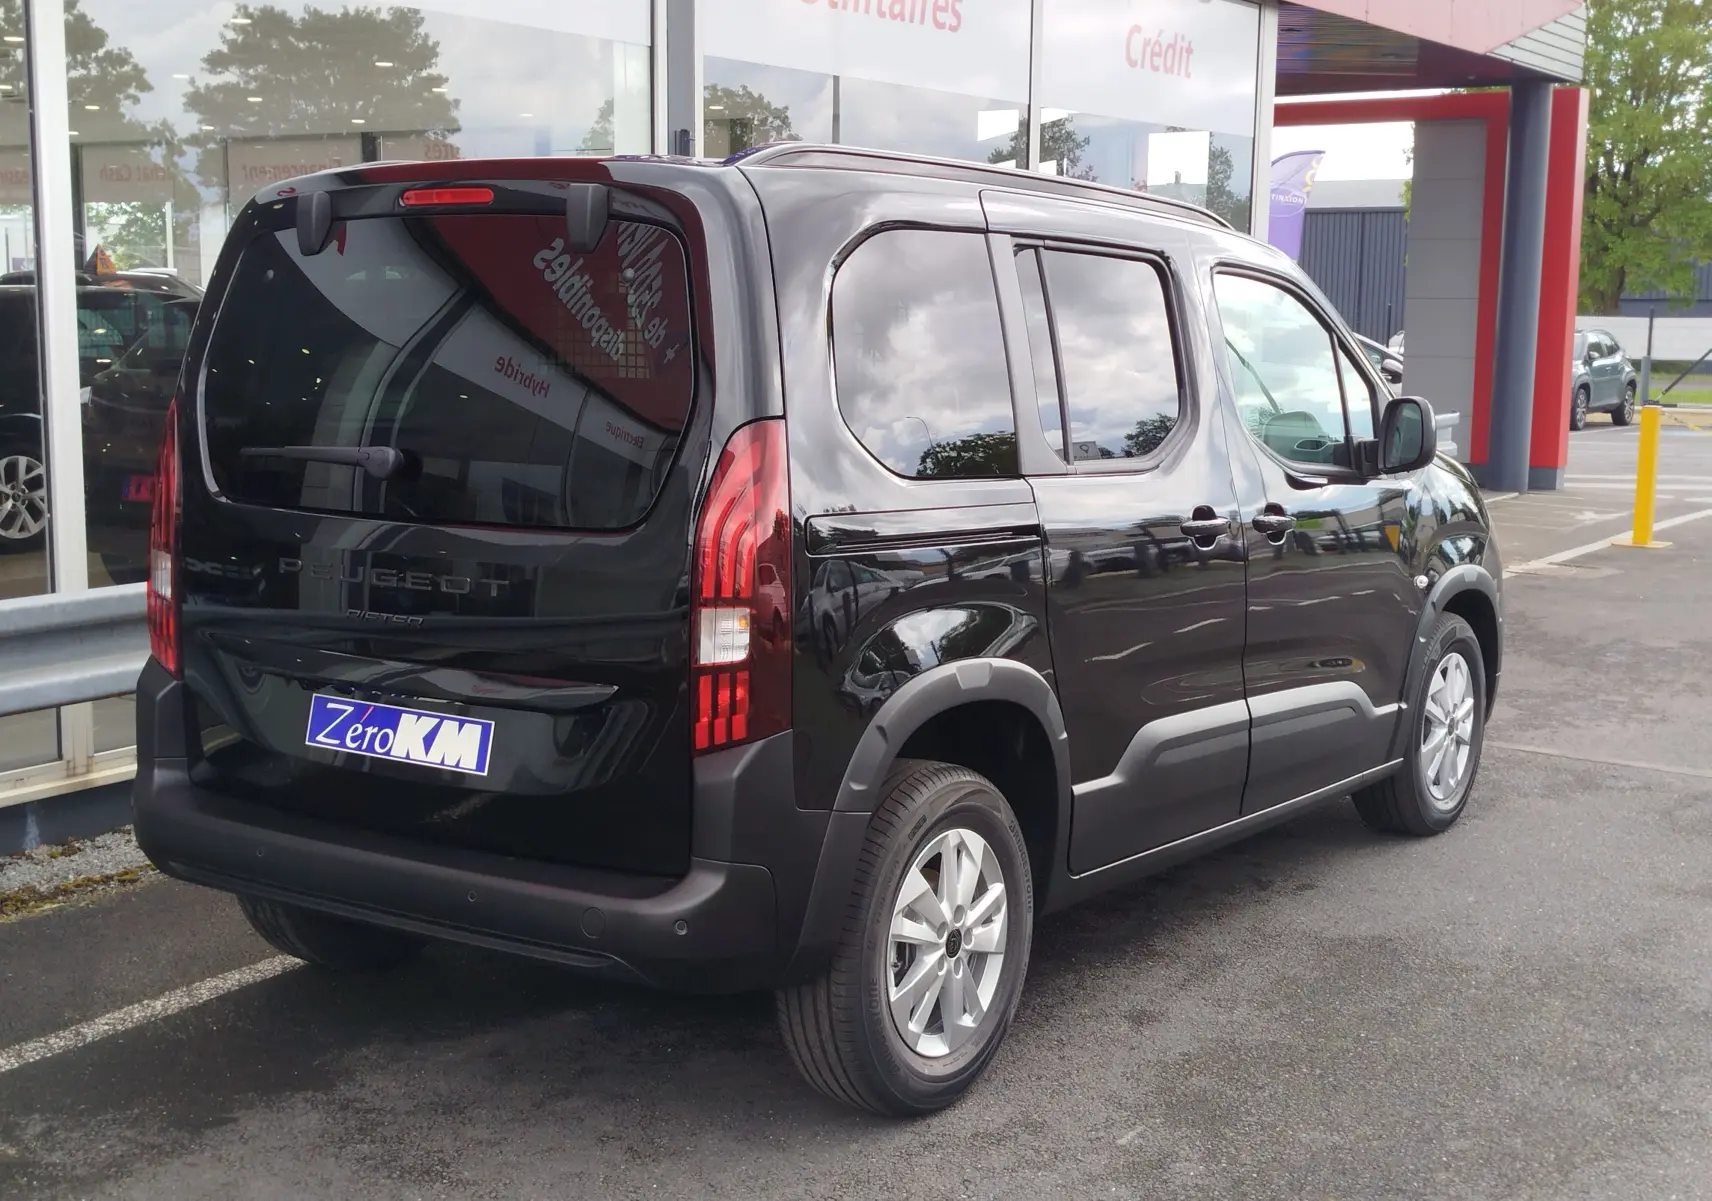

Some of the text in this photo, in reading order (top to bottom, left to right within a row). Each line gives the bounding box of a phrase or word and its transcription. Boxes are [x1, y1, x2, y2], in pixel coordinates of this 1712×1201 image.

[1125, 24, 1194, 79] Crédit
[278, 557, 510, 597] PEUGEOT
[346, 608, 424, 628] RIFTER
